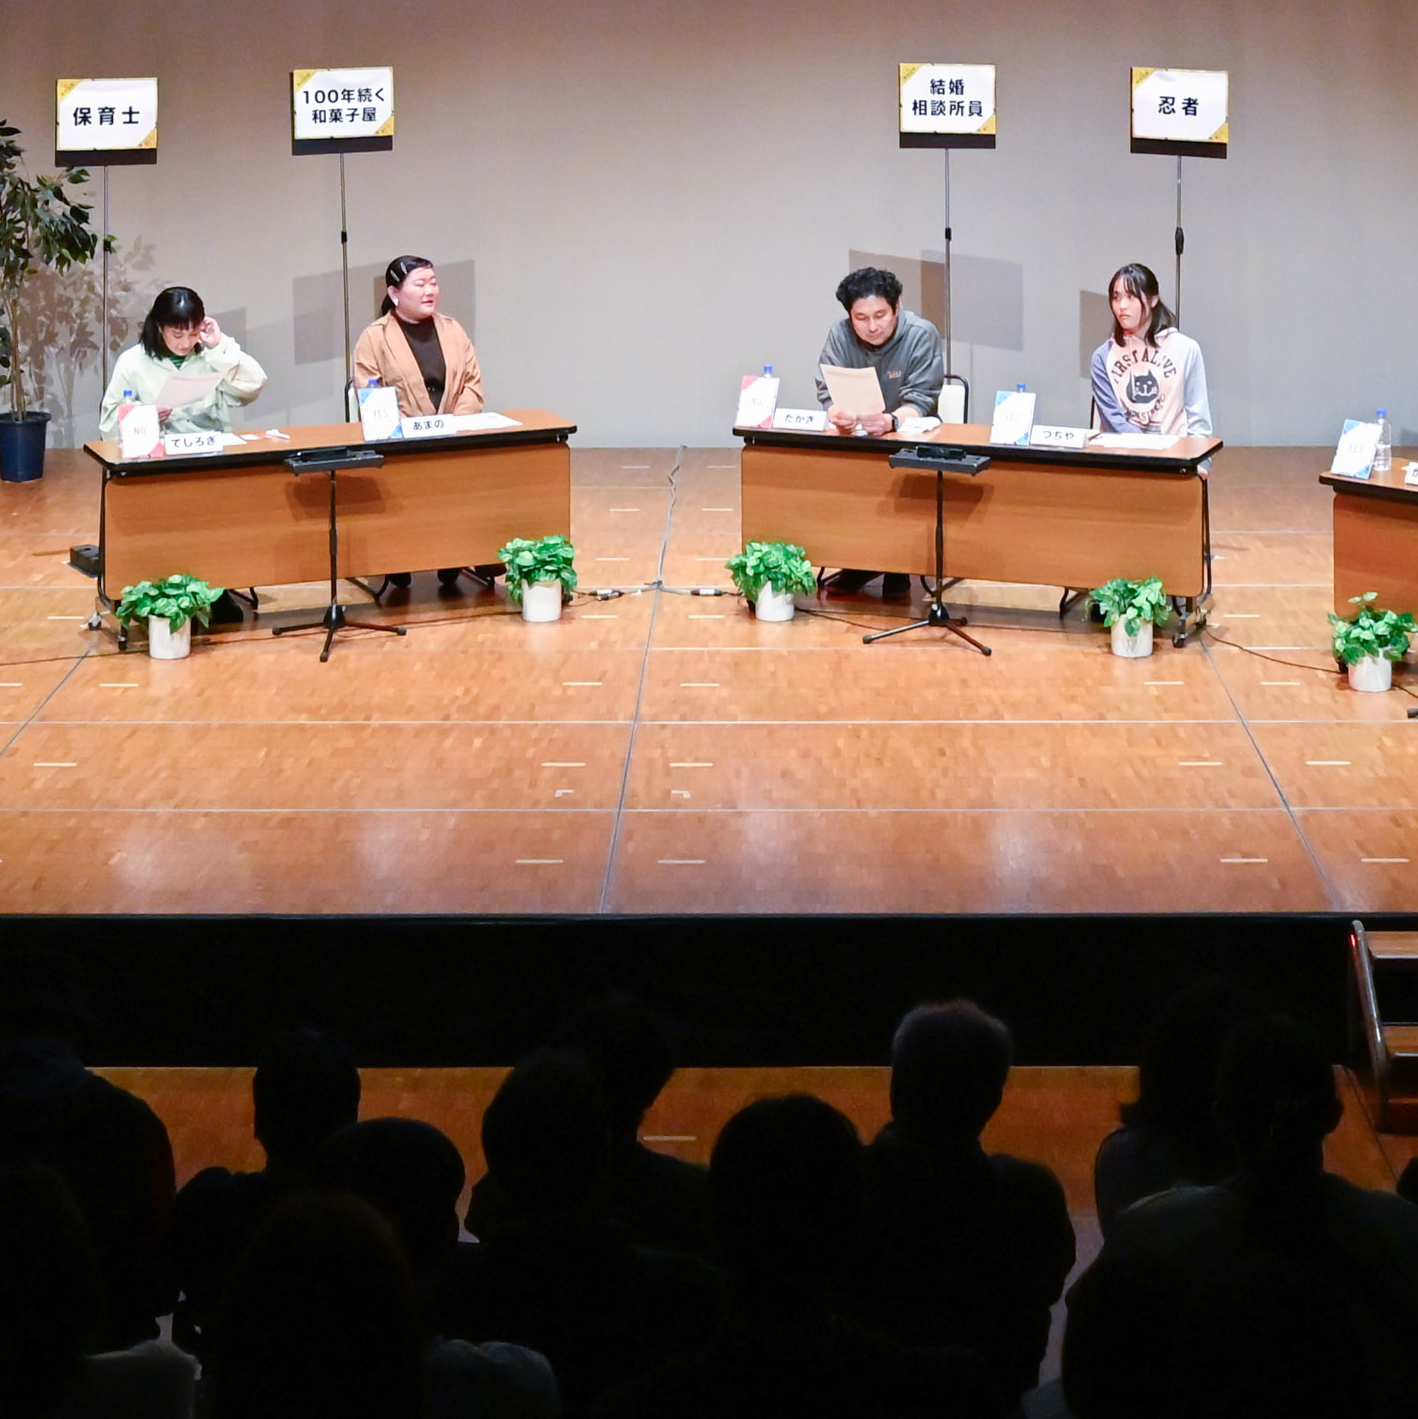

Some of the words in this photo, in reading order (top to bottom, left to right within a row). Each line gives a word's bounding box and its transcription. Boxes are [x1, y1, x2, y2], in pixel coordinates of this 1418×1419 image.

[303, 88, 385, 104] 100年続く
[930, 78, 965, 96] 結婚
[312, 107, 377, 124] 和菓子屋
[912, 99, 983, 118] 相談所員
[1158, 96, 1199, 117] 忍者
[73, 105, 140, 127] 保育士
[412, 419, 444, 431] あまの
